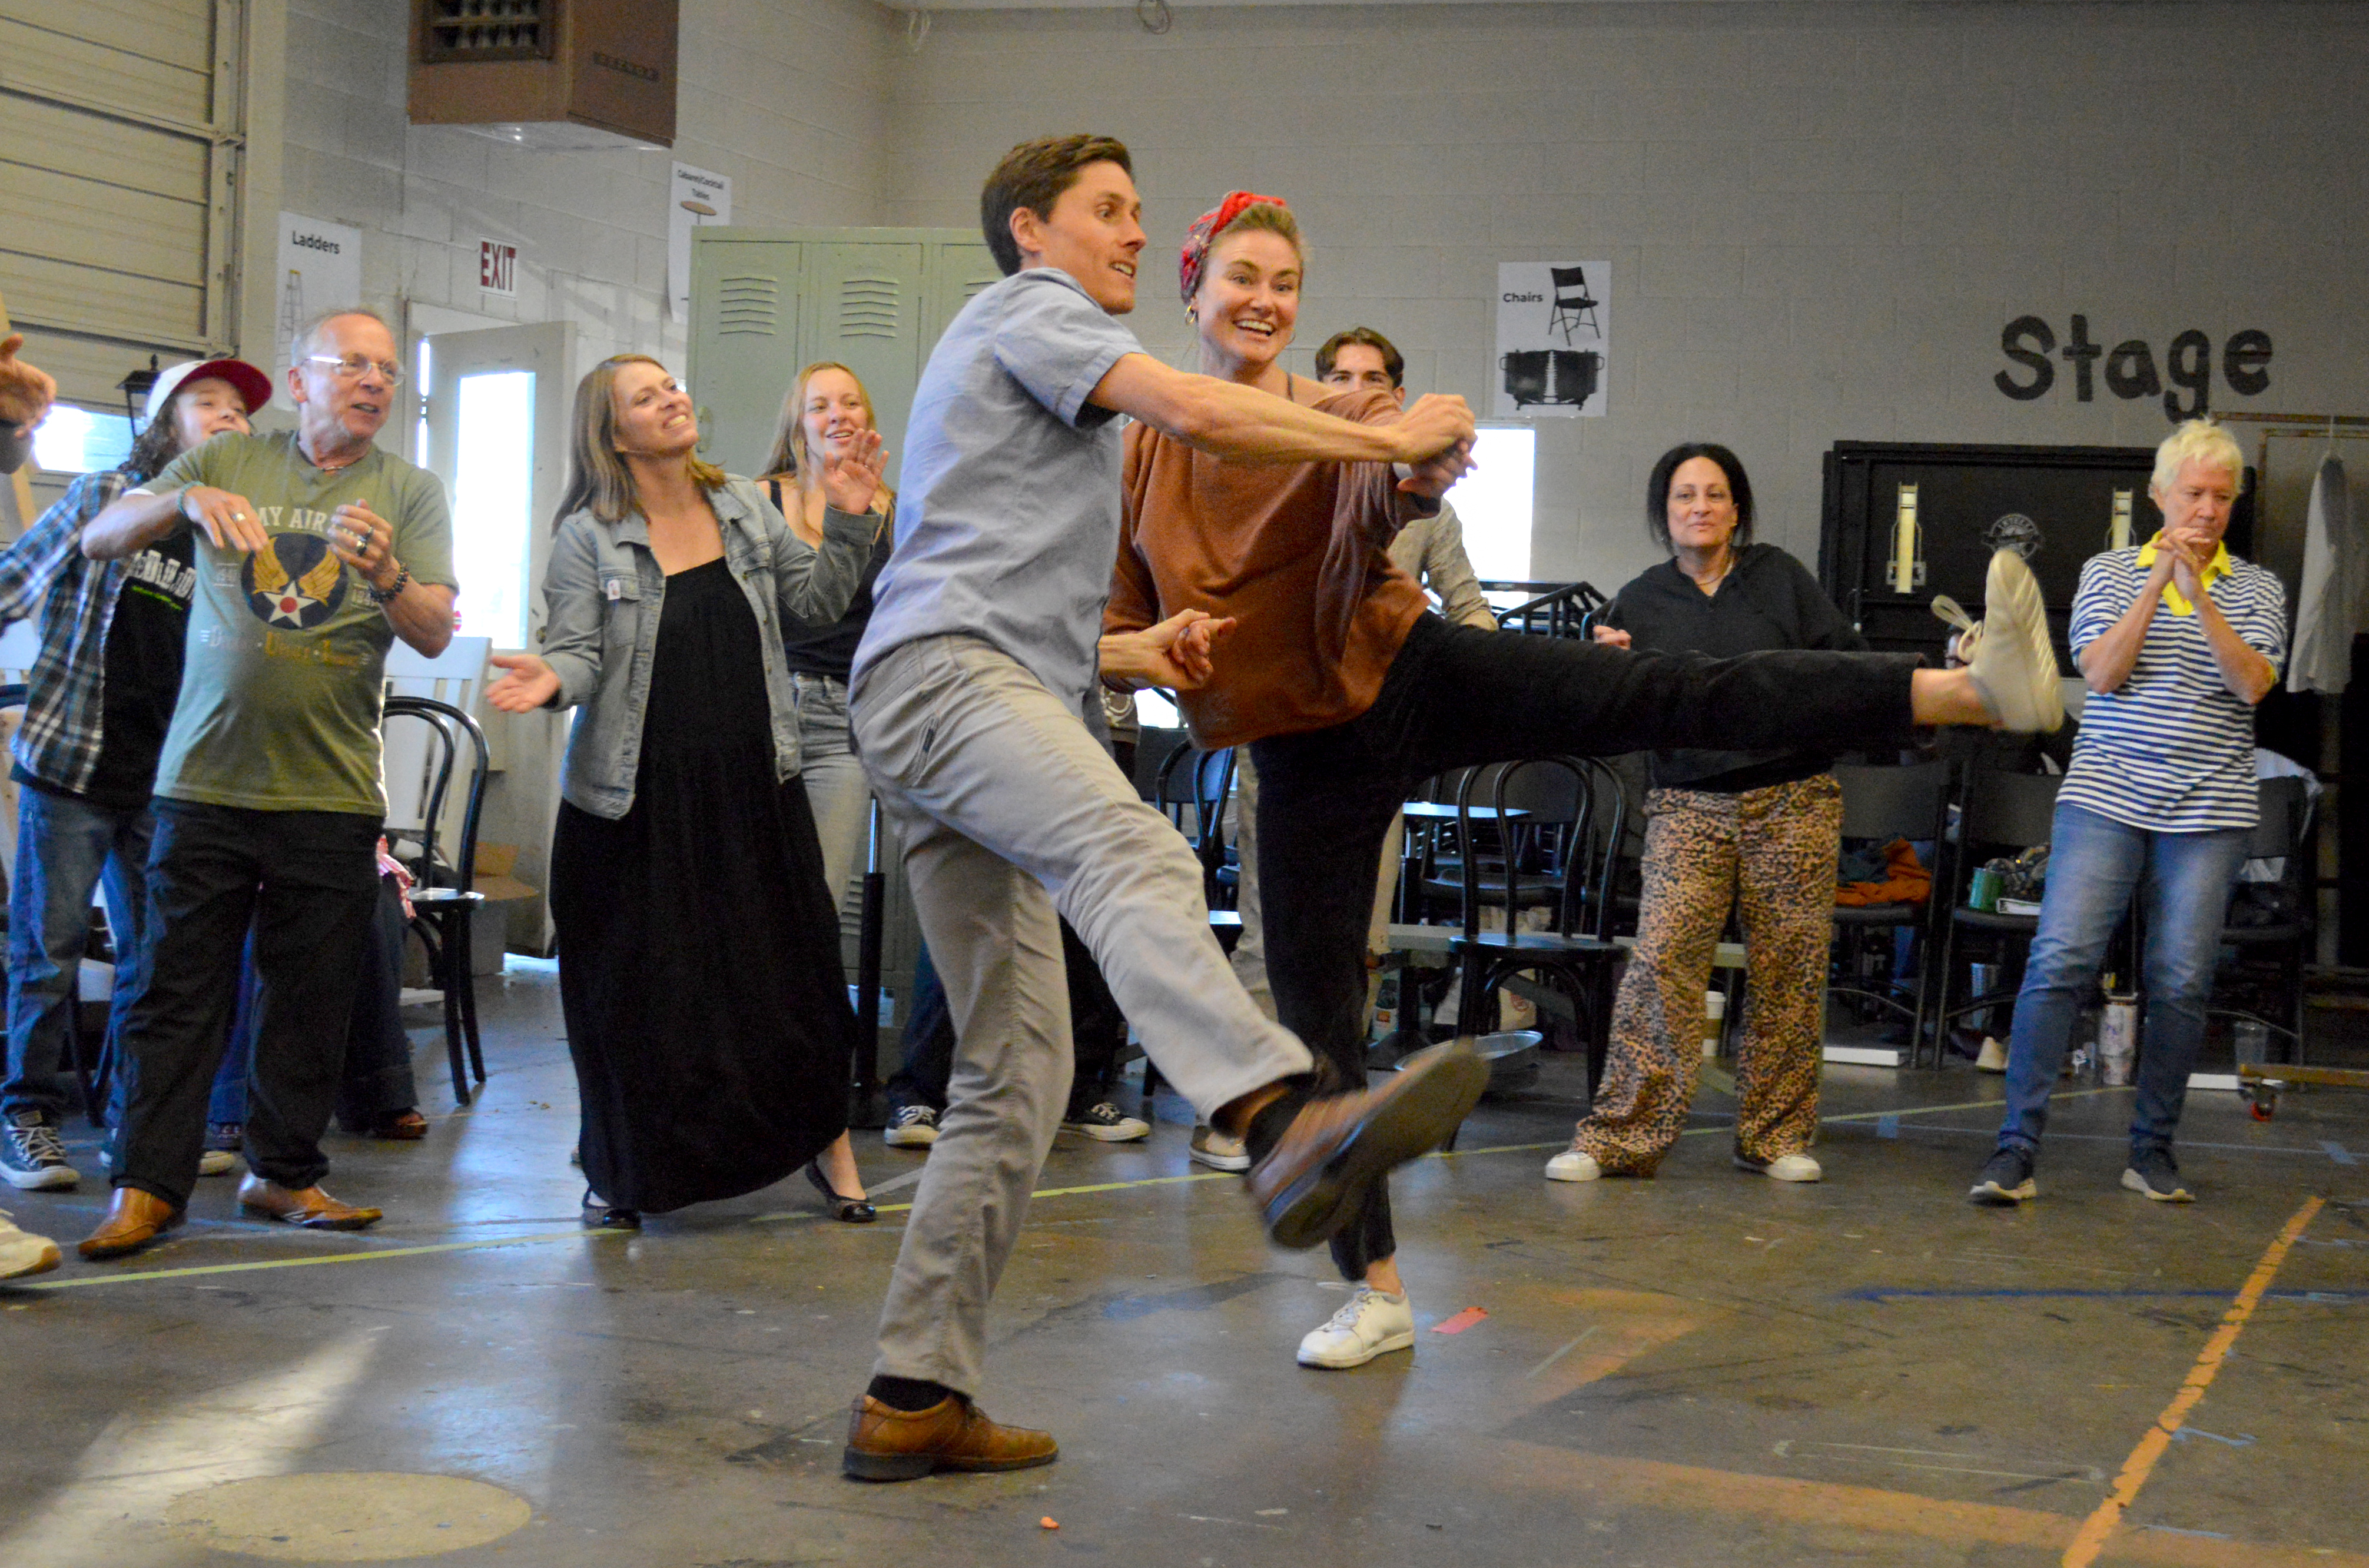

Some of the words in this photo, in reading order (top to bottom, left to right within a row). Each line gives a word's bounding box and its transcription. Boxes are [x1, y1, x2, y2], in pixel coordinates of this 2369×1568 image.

[292, 230, 340, 254] Ladders
[481, 241, 516, 291] EXIT
[1503, 291, 1544, 303] Chairs
[1994, 314, 2273, 424] Stage
[288, 507, 327, 532] AIR
